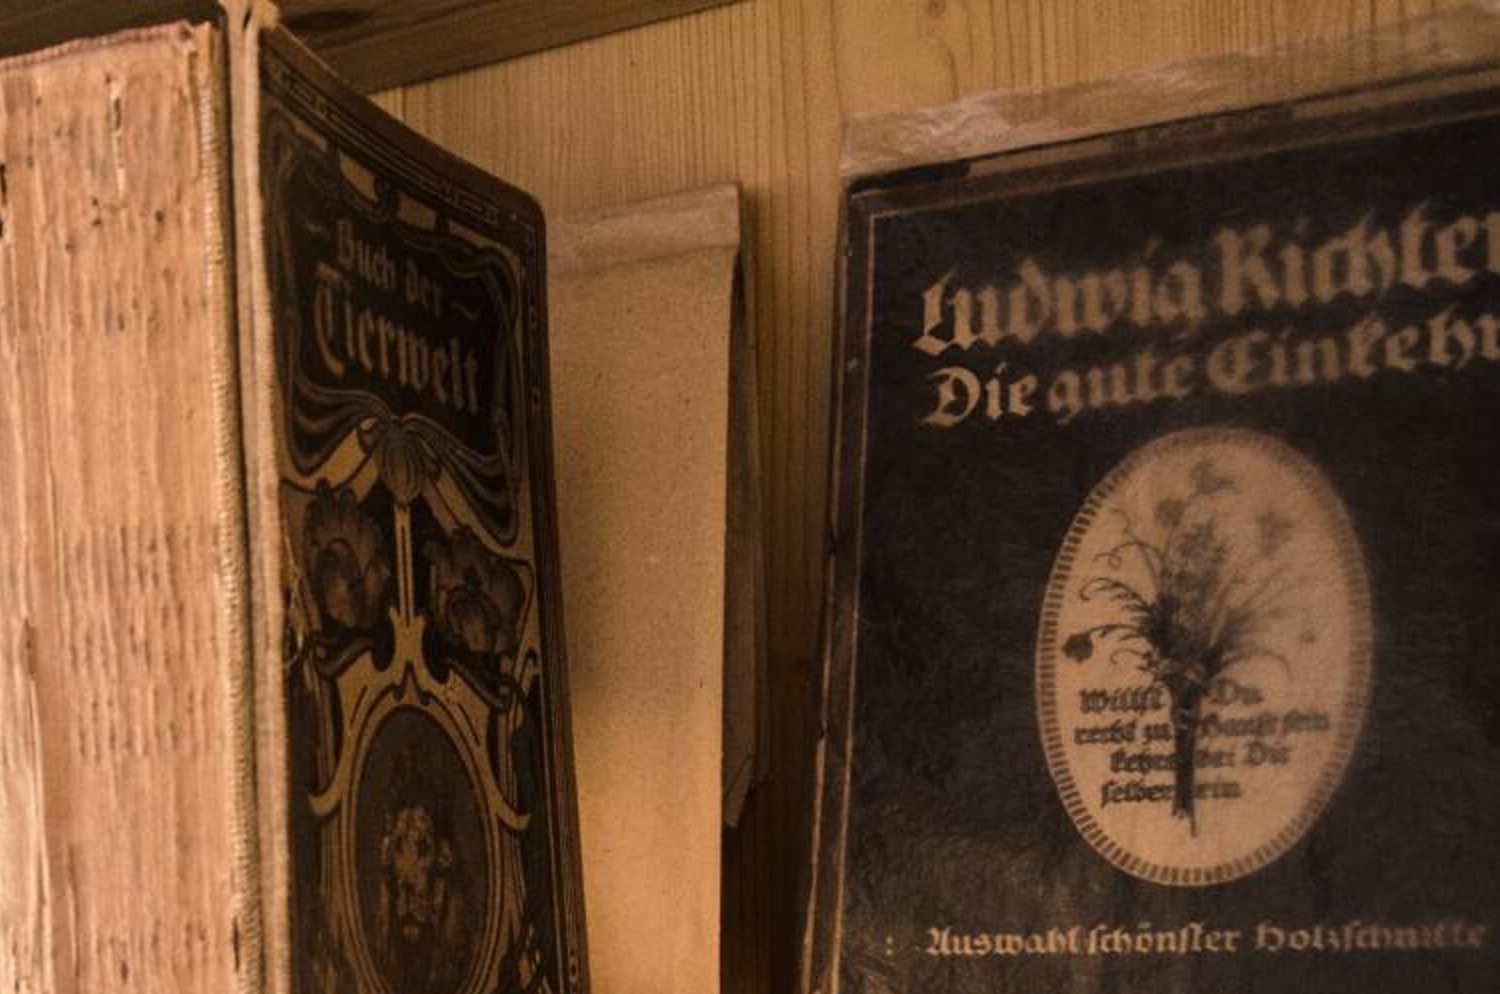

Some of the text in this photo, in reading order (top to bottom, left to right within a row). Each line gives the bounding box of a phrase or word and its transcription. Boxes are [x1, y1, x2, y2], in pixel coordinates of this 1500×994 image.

[912, 238, 1206, 356] Ludwig
[922, 360, 1038, 427] Die
[1048, 346, 1192, 424] gute
[924, 923, 1080, 957] Auswahl
